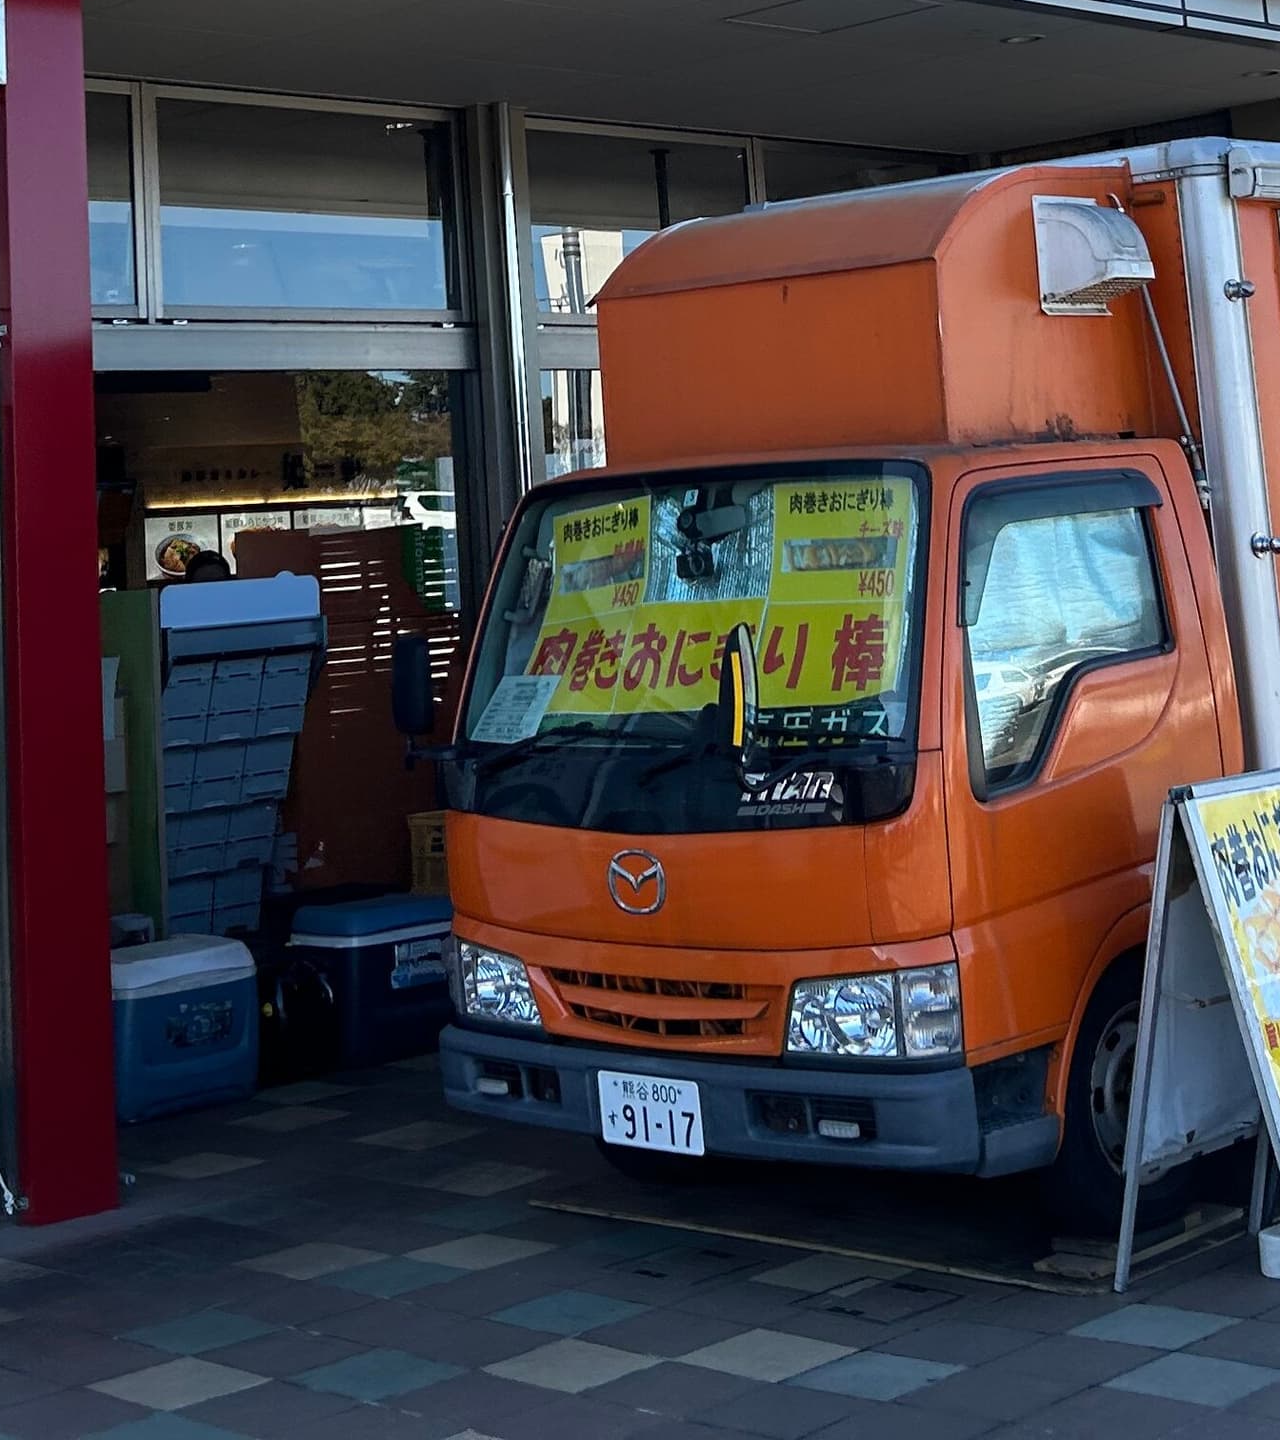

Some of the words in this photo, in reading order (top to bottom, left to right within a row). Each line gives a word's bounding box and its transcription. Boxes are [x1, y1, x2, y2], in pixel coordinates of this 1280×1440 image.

[787, 479, 895, 515] 肉巻きおにぎり棒
[563, 507, 640, 545] 肉巻きおにぎり棒
[857, 520, 905, 539] チーズ味
[611, 581, 640, 609] ¥450
[856, 568, 896, 599] ¥450
[757, 802, 806, 816] DASH
[622, 1079, 650, 1102] 熊谷
[651, 1082, 678, 1106] 800
[607, 1109, 619, 1130] す
[622, 1103, 696, 1149] 91-17
